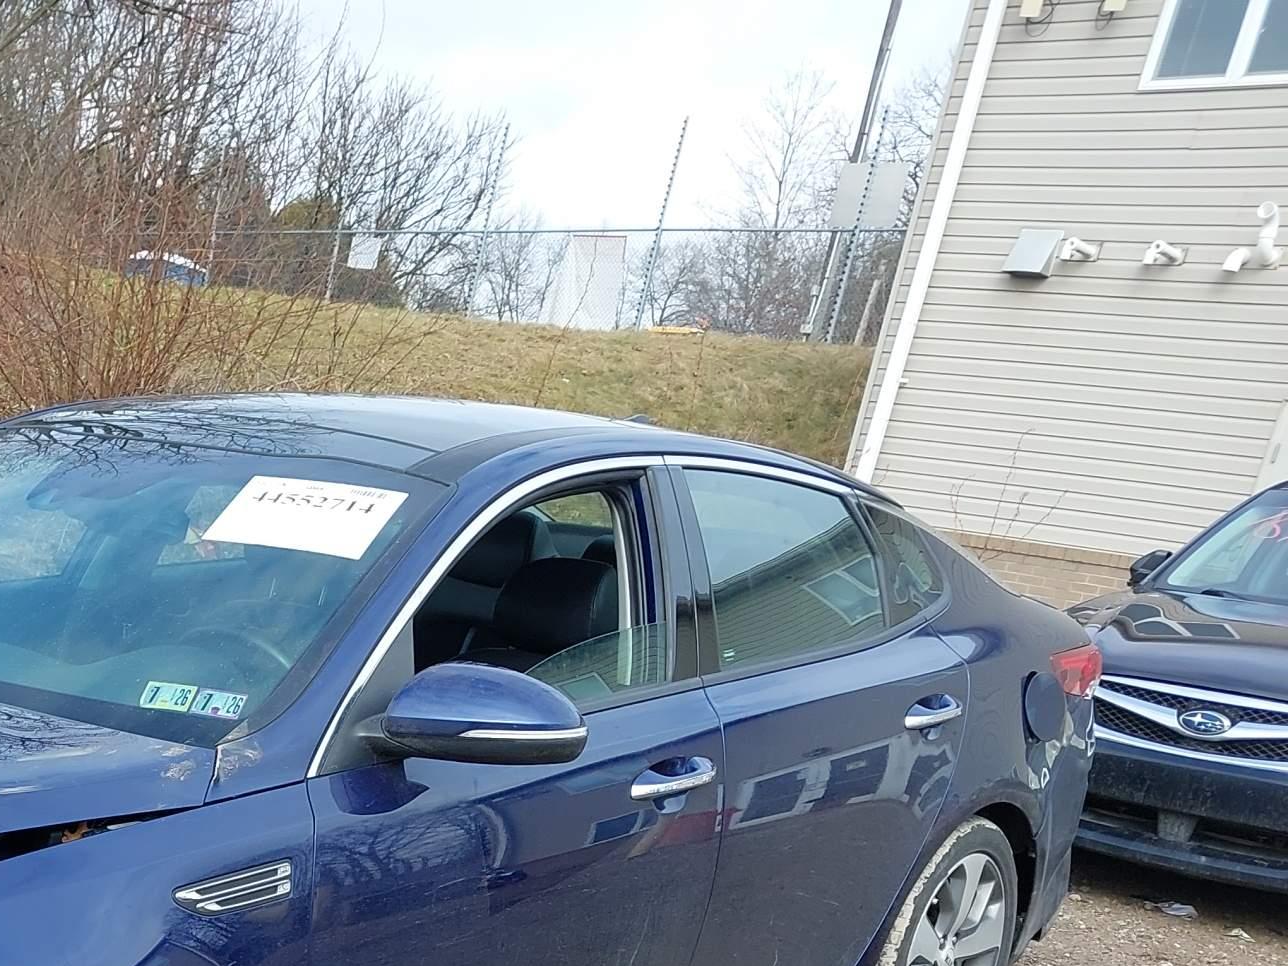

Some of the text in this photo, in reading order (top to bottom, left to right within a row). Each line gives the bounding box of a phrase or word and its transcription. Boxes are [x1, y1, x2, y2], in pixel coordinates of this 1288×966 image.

[253, 491, 375, 514] 44552714
[149, 686, 192, 706] 7 26
[201, 693, 243, 715] 7 26
